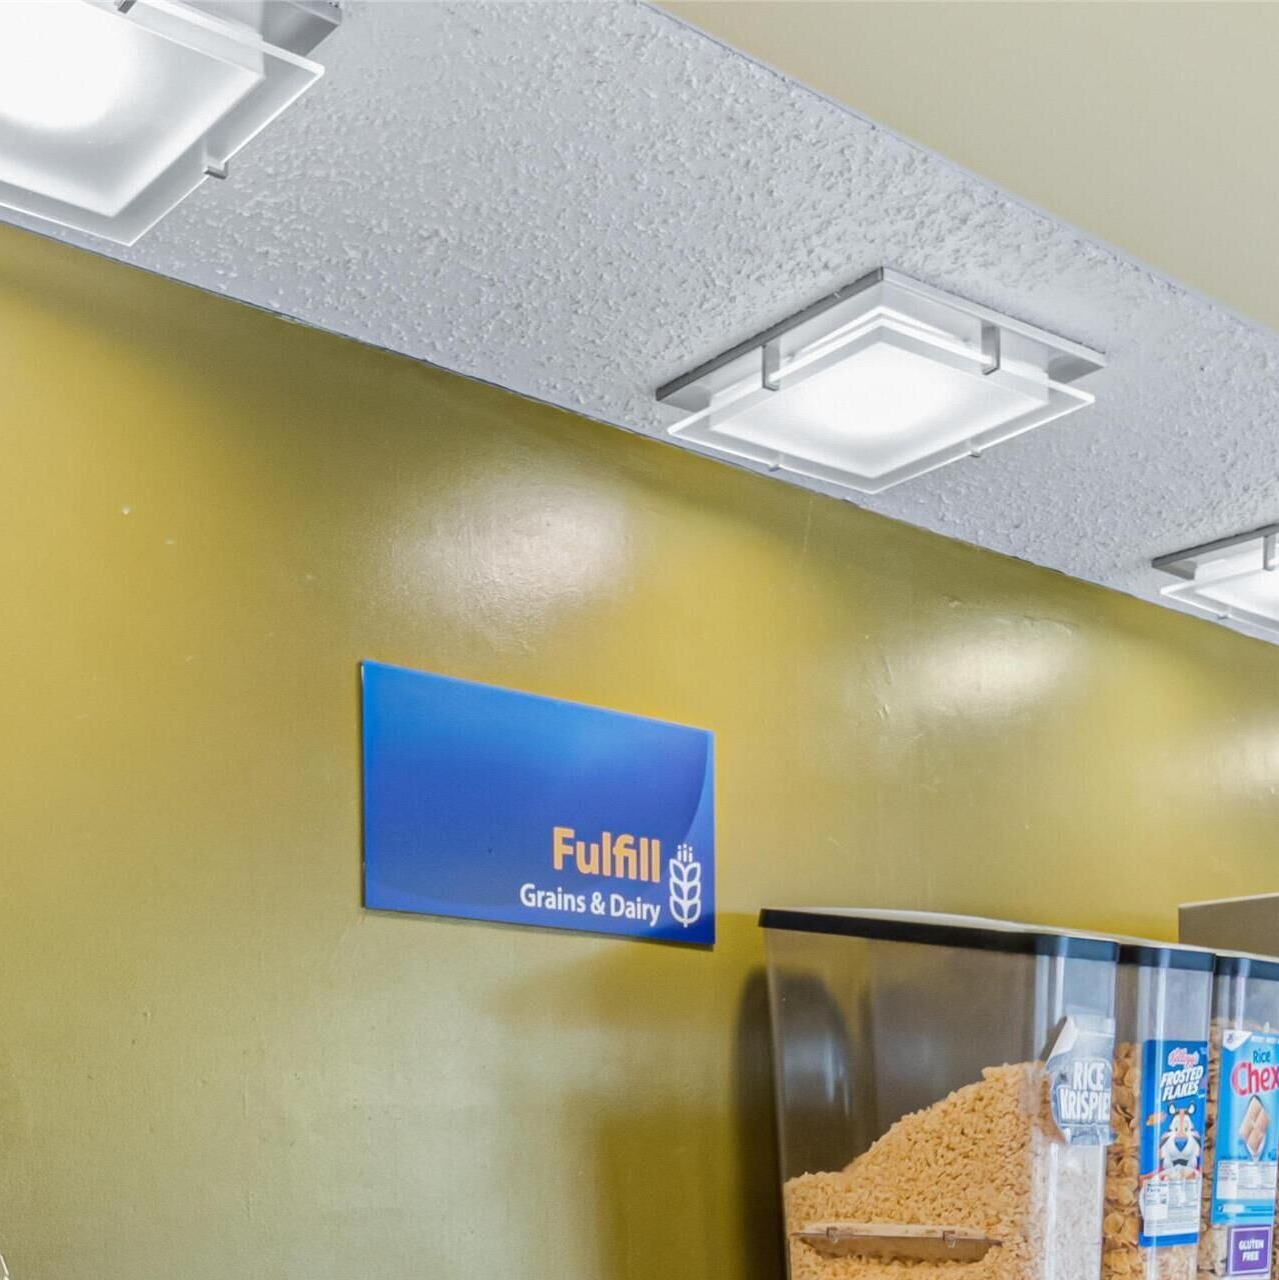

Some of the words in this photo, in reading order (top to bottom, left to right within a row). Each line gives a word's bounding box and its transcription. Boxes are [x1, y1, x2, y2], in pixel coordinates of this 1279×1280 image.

[553, 826, 661, 883] Fulfill
[520, 883, 586, 913] Grains
[590, 891, 606, 915] &
[610, 893, 661, 927] Dairy
[1253, 1049, 1271, 1063] Rice
[1073, 1061, 1105, 1090] RICE
[1161, 1065, 1203, 1088] FROSTED
[1163, 1081, 1198, 1101] FLAKES
[1238, 1239, 1265, 1251] GLUTEN
[1242, 1251, 1260, 1262] FREE
